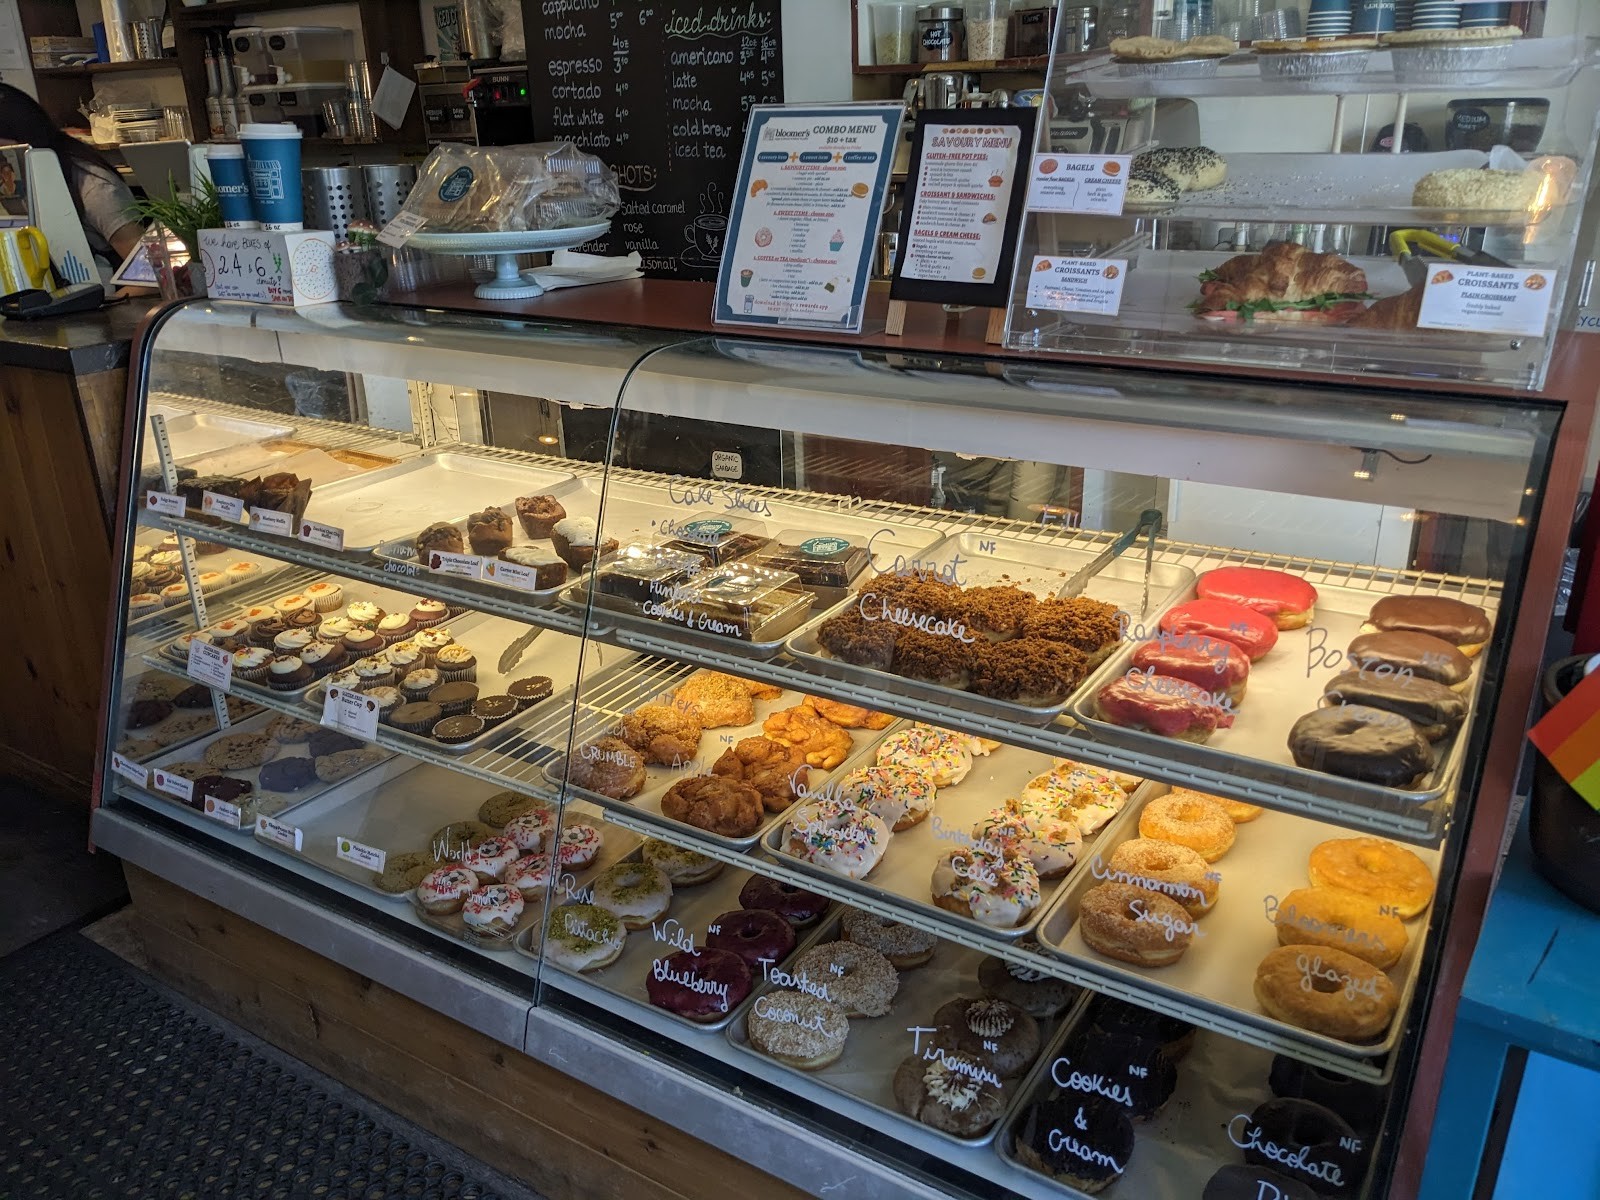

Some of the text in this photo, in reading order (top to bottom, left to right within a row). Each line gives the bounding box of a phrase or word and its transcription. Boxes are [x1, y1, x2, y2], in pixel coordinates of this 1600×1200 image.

[544, 19, 587, 40] mocha
[664, 8, 706, 34] iced
[670, 46, 734, 65] americano
[548, 57, 603, 82] espresso
[672, 71, 698, 88] latte
[552, 81, 602, 100] cortado
[672, 94, 712, 112] mocha
[553, 105, 604, 127] flat white
[672, 118, 701, 137] cold
[702, 118, 732, 138] brew
[775, 128, 811, 138] bloomer's
[812, 125, 877, 134] COMBO MENU
[674, 141, 728, 159] iced tea
[931, 137, 1013, 149] SAVOURY MENU
[1066, 163, 1095, 171] BAGELS
[215, 182, 249, 193] omer's
[919, 190, 950, 198] CROISSANT
[620, 200, 685, 215] Salted caramel
[623, 222, 644, 234] rose
[242, 237, 261, 249] BOXES
[624, 238, 660, 251] vanilla
[254, 256, 266, 277] 6
[1054, 266, 1101, 276] CROISSANTS
[1466, 270, 1514, 279] PLANT-BASED
[1457, 278, 1519, 290] CROISSANTS
[1460, 291, 1517, 302] PLAIN CROISSANT
[714, 452, 739, 463] ORGANIC
[714, 464, 739, 473] GARBAGE
[669, 474, 772, 516] Cake Slices
[867, 528, 968, 586] Carrot
[979, 540, 996, 555] NF
[643, 600, 685, 622] Cookies
[698, 611, 742, 637] Cream
[859, 592, 975, 643] Cheesecake
[1112, 610, 1231, 674] Raspberry
[1305, 625, 1415, 688] Boston
[1126, 666, 1240, 714] Cheesecake
[354, 700, 363, 708] Cup
[719, 735, 733, 745] NF
[580, 742, 636, 768] CRUMBLE
[787, 764, 856, 811] Vanilla
[999, 826, 1015, 837] NF
[433, 827, 472, 864] World
[952, 856, 998, 887] Cake
[1090, 853, 1208, 907] Cinnamon
[1128, 899, 1207, 942] Sugar
[1379, 905, 1399, 918] NF
[564, 912, 622, 950] Pistachio
[652, 918, 721, 957] Wild NF
[829, 962, 844, 978] NF
[652, 958, 729, 1013] Blueberry
[754, 996, 834, 1038] Coconut
[906, 1025, 1003, 1089] Tiramisu NF
[1051, 1057, 1148, 1107] Cookies NF
[1073, 1106, 1087, 1131] &
[1048, 1128, 1124, 1174] Cream
[1227, 1113, 1362, 1187] Chocolate NF
